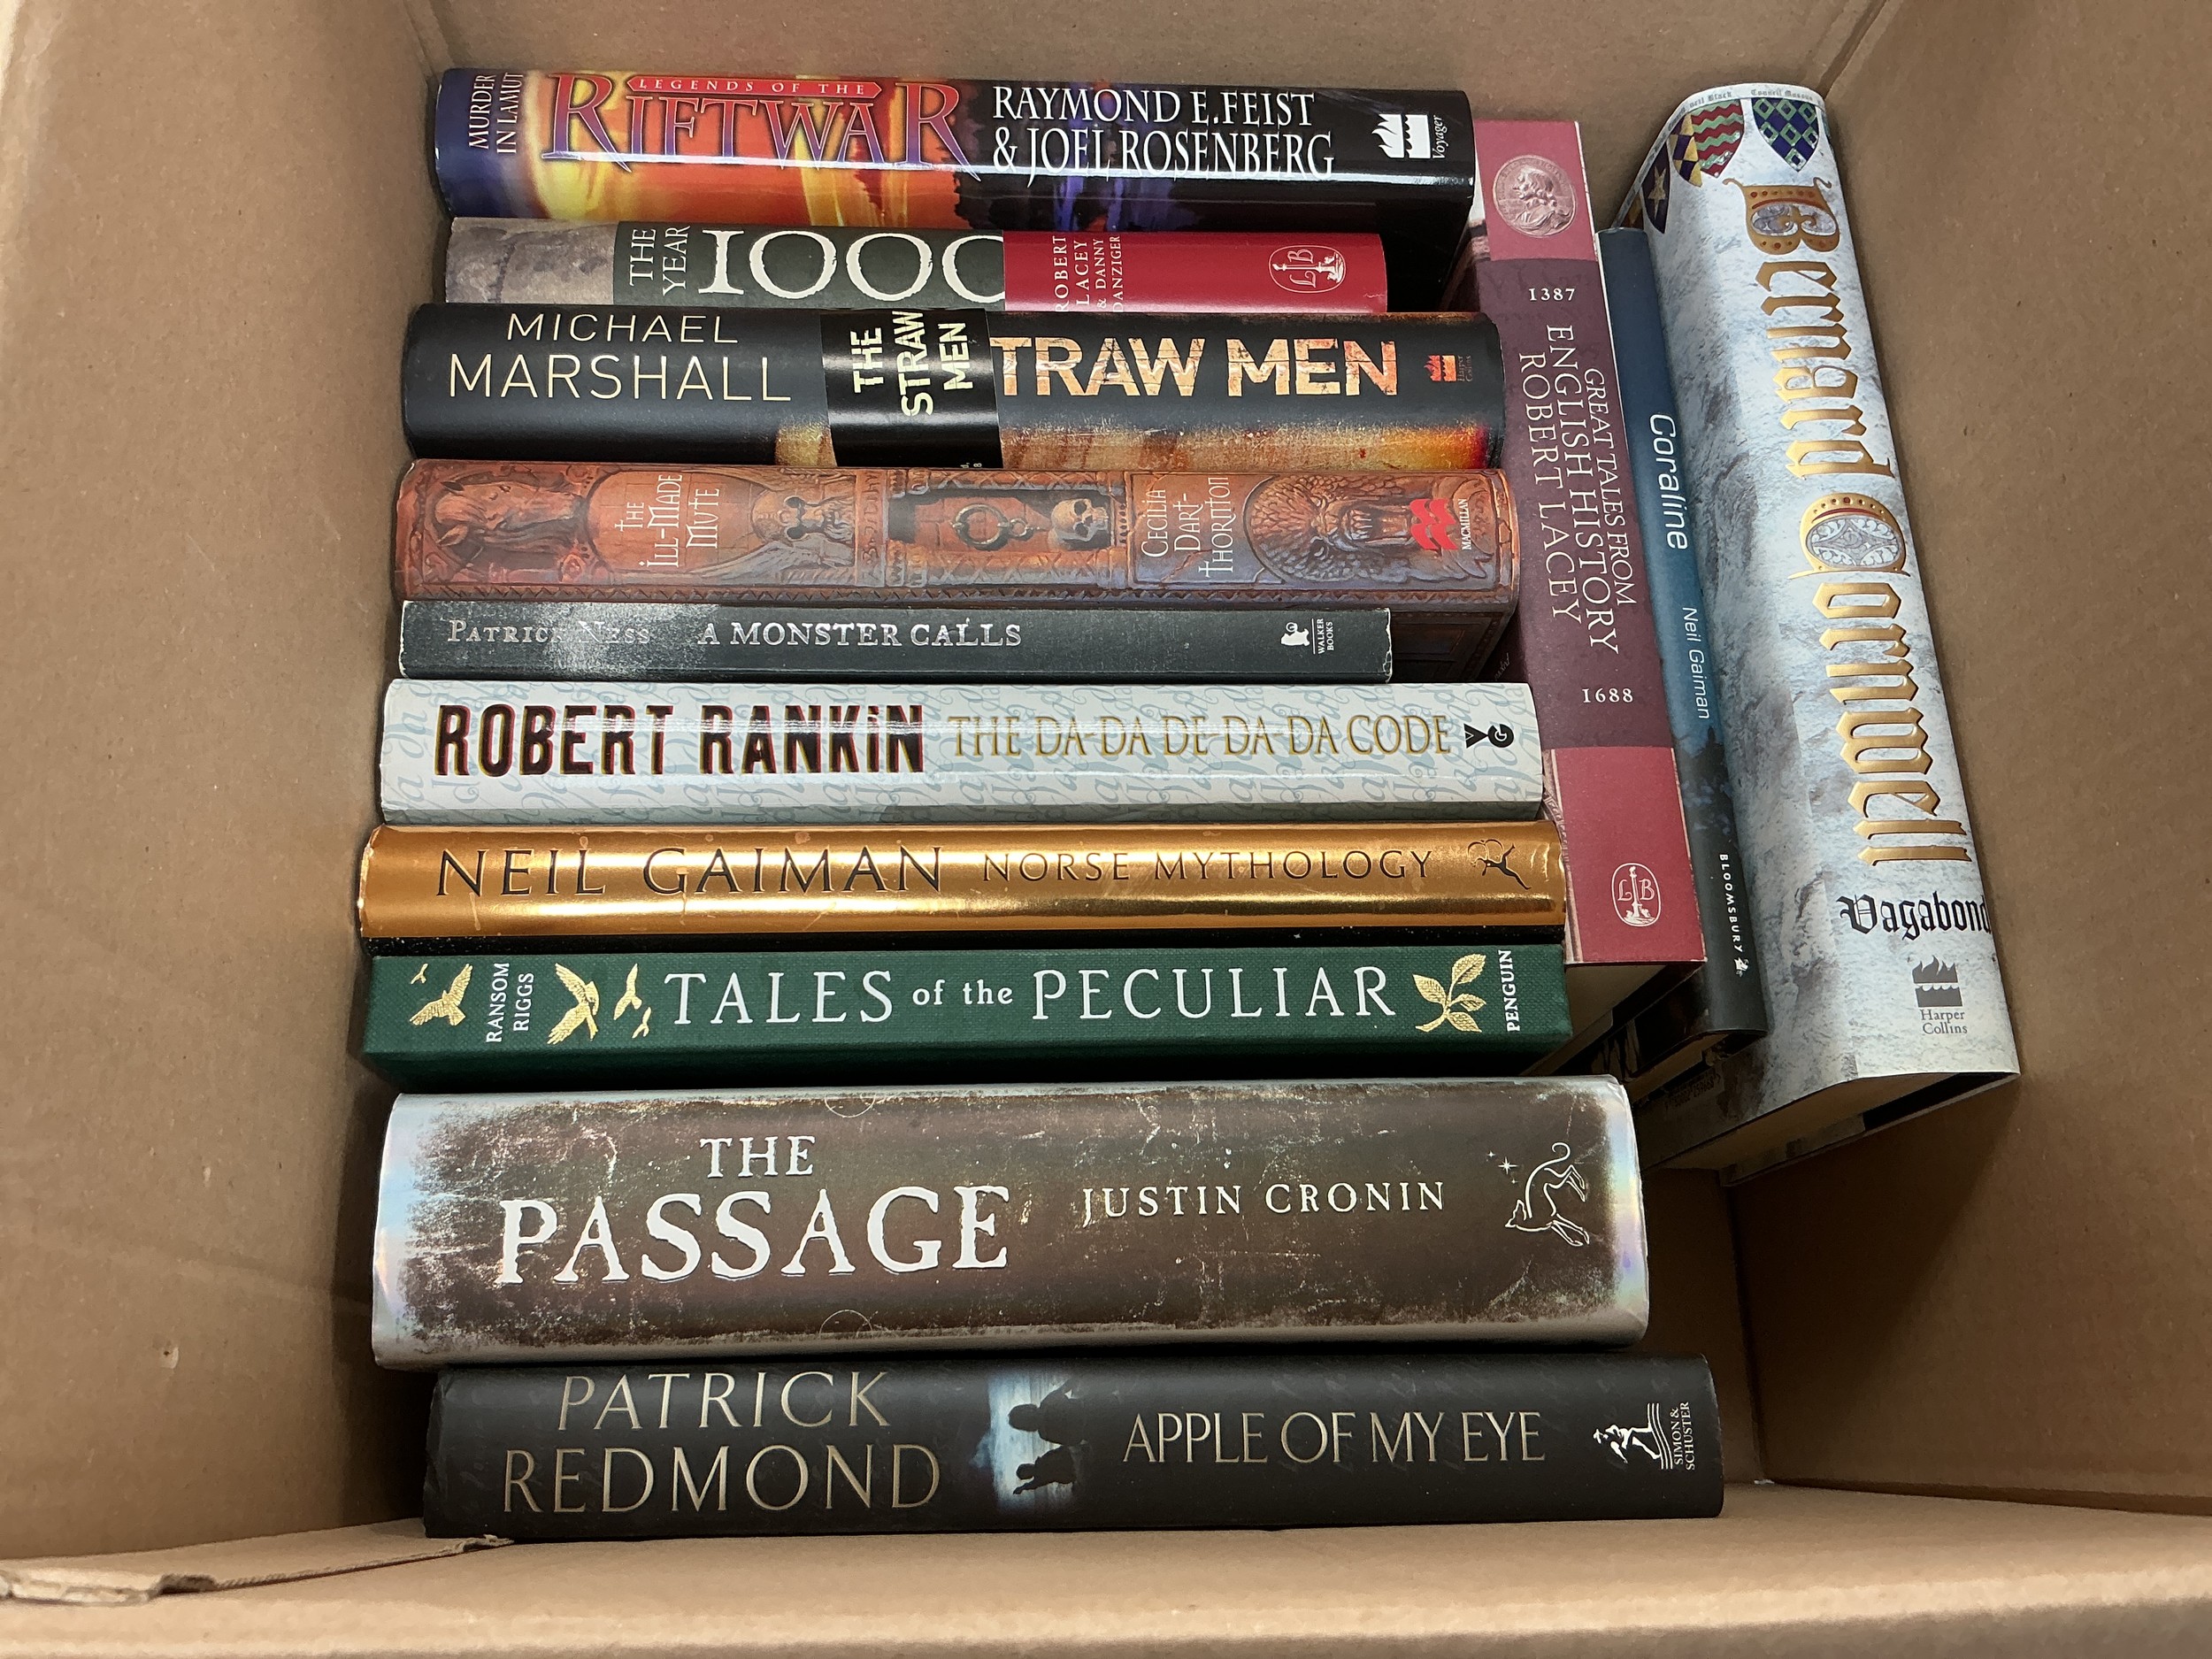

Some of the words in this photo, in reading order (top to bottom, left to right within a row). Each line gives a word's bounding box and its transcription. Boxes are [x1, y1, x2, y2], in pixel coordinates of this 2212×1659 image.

[469, 73, 497, 150] MURDER
[497, 72, 524, 125] LAMUT
[640, 78, 754, 93] LEGENDS
[772, 82, 800, 94] OF
[821, 83, 865, 96] THE
[993, 86, 1180, 124] RAYMOND
[496, 129, 518, 154] IN
[541, 73, 981, 182] RIFTWAR
[993, 128, 1019, 174] &
[1027, 127, 1112, 188] JOEL
[1119, 129, 1336, 182] ROSENBERG
[1432, 114, 1449, 159] Voyager
[629, 227, 657, 286] THE
[663, 225, 691, 296] YEAR
[1052, 235, 1070, 312] ROBERT
[1073, 240, 1091, 307] LACEY
[1093, 238, 1107, 290] DANNY
[1109, 235, 1125, 312] DANZIGER
[1097, 298, 1107, 310] &
[1528, 287, 1576, 303] 1387
[506, 313, 738, 344] MICHAEL
[938, 322, 973, 390] MEN
[1722, 177, 1896, 480] Bernard
[449, 353, 792, 402] MARSHALL
[850, 327, 884, 394] THE
[892, 311, 934, 417] STRAW
[989, 336, 1206, 397] TRAW
[1227, 337, 1398, 397] MEN
[1518, 352, 1566, 489] ROBERT
[1546, 324, 1594, 480] ENGLISH
[1584, 368, 1615, 449] GREAT
[1595, 452, 1626, 527] TALES
[1649, 413, 1689, 550] Coraline
[614, 501, 645, 532] THE
[686, 488, 719, 549] MUTE
[1141, 489, 1169, 557] CECILIA
[1197, 476, 1237, 579] THORNTON
[1458, 498, 1471, 550] MACMILLAN
[1538, 502, 1583, 625] LACEY
[1569, 488, 1619, 655] HISTORY
[1606, 532, 1638, 607] FROM
[697, 622, 721, 646] A
[731, 622, 902, 648] MONSTER
[910, 620, 1023, 648] CALLS
[1317, 618, 1325, 655] WALKER
[1682, 606, 1702, 642] Neil
[1581, 687, 1634, 704] 1688
[1688, 649, 1710, 720] Gaiman
[1787, 492, 1973, 867] Cornwell
[434, 704, 675, 778] ROBERT
[948, 715, 1022, 757] THE
[1347, 714, 1452, 757] CODE
[435, 846, 607, 898] NEIL
[642, 845, 943, 897] GAIMAN
[982, 850, 1130, 883] NORSE
[1154, 849, 1433, 883] MYTHOLOGY
[1719, 854, 1743, 953] BLOOMSBURY
[1836, 890, 1993, 941] Vagabond
[486, 962, 510, 1043] RANSOM
[513, 972, 534, 1032] RIGGS
[664, 970, 894, 1024] TALES
[912, 979, 946, 1006] of
[962, 979, 1014, 1006] the
[1032, 965, 1397, 1021] PECULIAR
[1498, 949, 1520, 1032] PENGUIN
[1920, 1009, 1966, 1025] Harper
[1922, 1022, 1969, 1035] Collins
[700, 1135, 817, 1179] THE
[495, 1184, 1011, 1286] PASSAGE
[1081, 1185, 1242, 1228] JUSTIN
[1264, 1181, 1446, 1217] CRONIN
[558, 1371, 892, 1432] PATRICK
[1670, 1407, 1679, 1418] &
[1122, 1412, 1269, 1465] APPLE
[1280, 1411, 1357, 1464] OF
[1369, 1410, 1446, 1463] MY
[1460, 1410, 1547, 1463] EYE
[1671, 1420, 1684, 1465] SIMON
[1680, 1402, 1696, 1471] SCHUSTER
[503, 1443, 941, 1514] REDMOND
